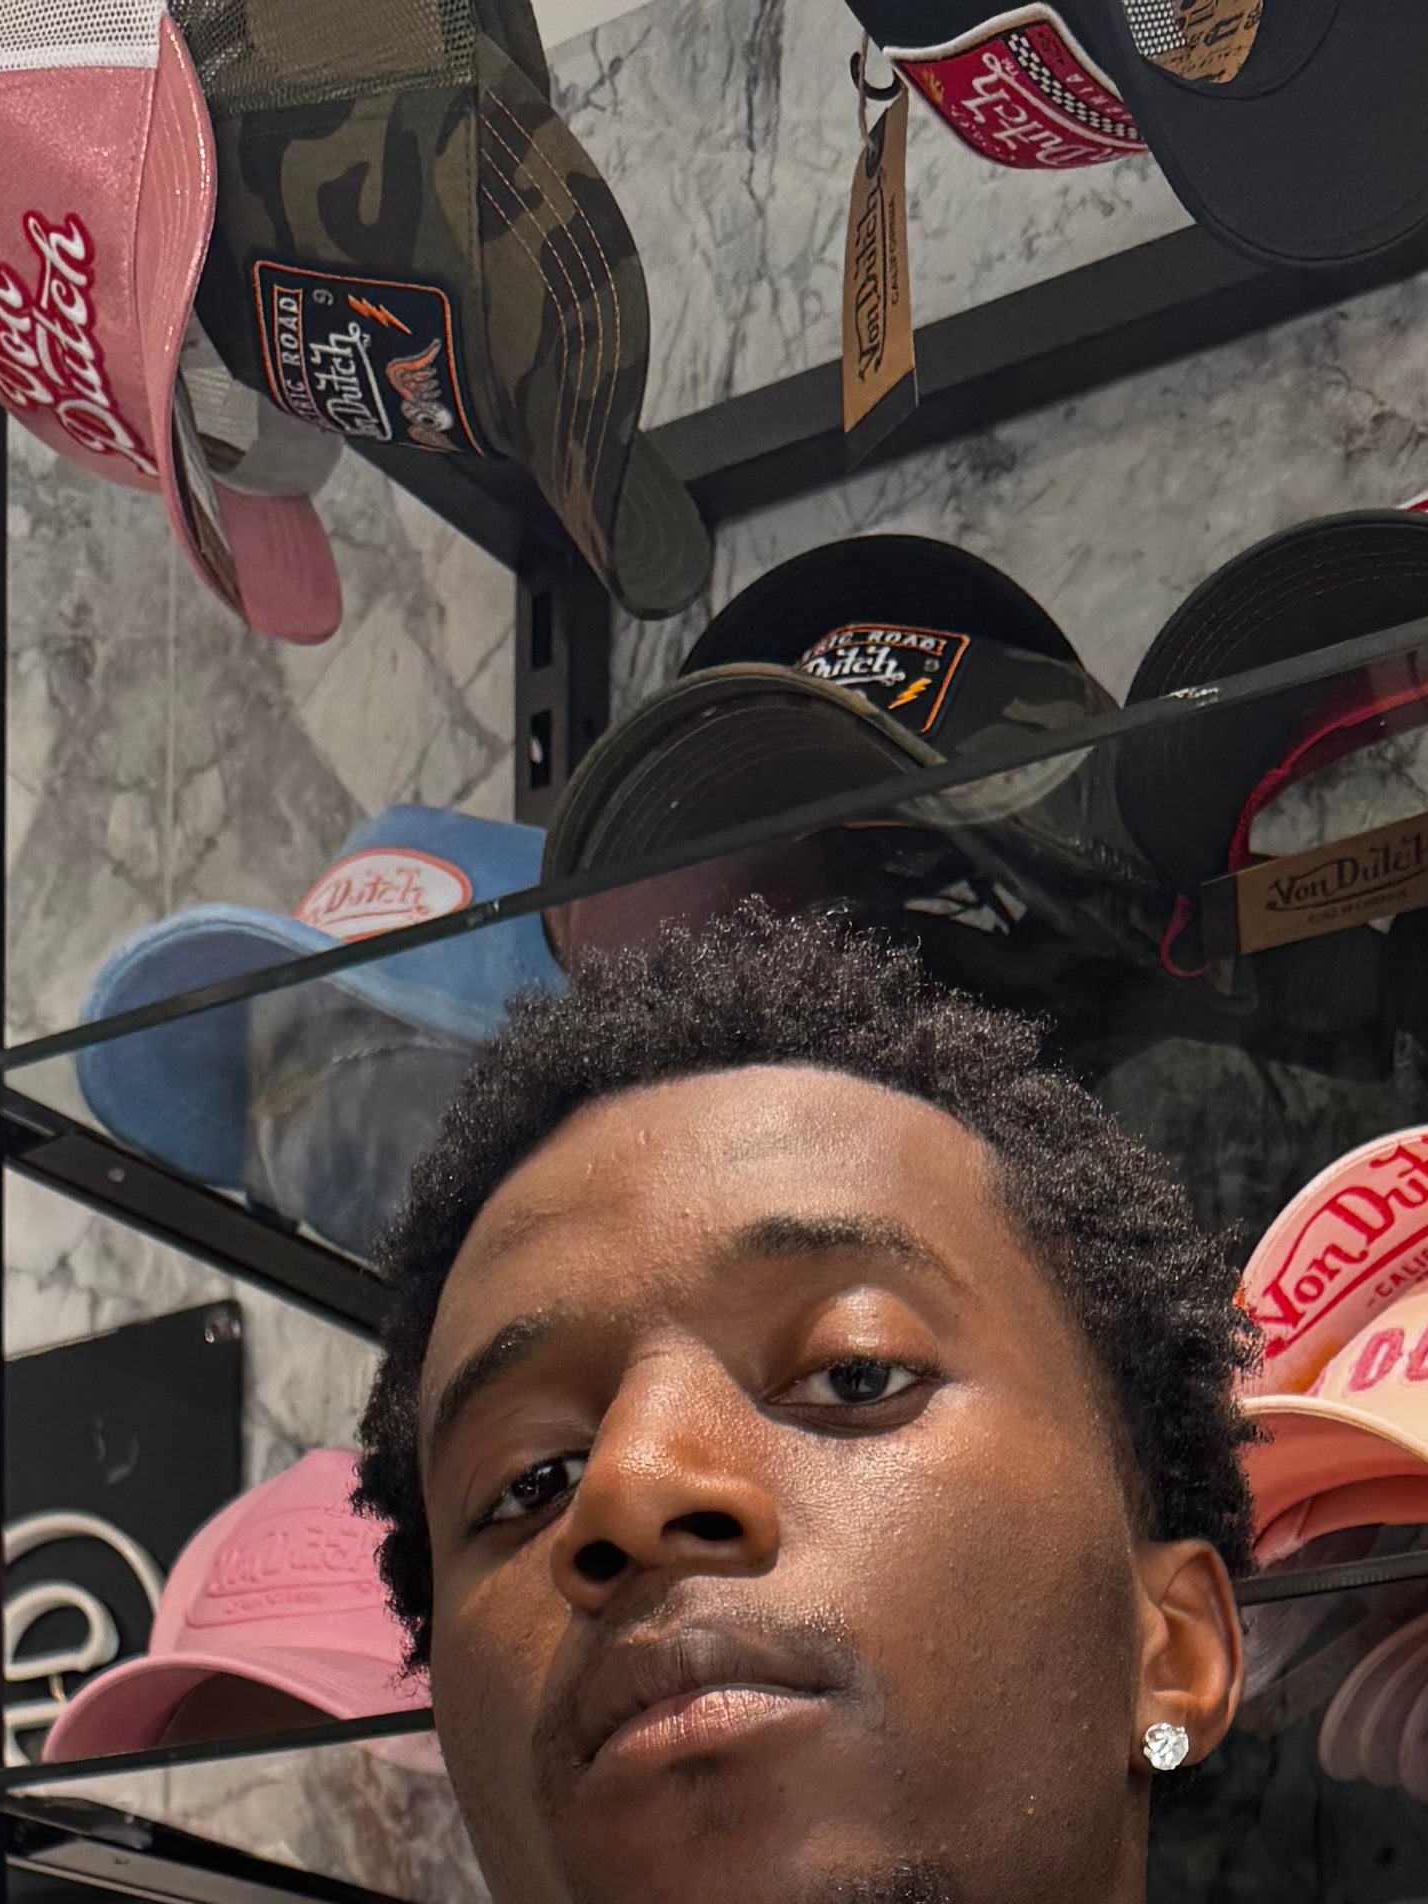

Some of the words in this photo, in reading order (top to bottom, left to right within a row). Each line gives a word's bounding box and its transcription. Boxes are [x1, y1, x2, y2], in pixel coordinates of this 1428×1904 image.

[24, 213, 160, 477] Dutch
[278, 296, 301, 367] ROAD
[858, 295, 881, 382] Von
[1267, 874, 1331, 908] Von
[1249, 1241, 1369, 1332] Von
